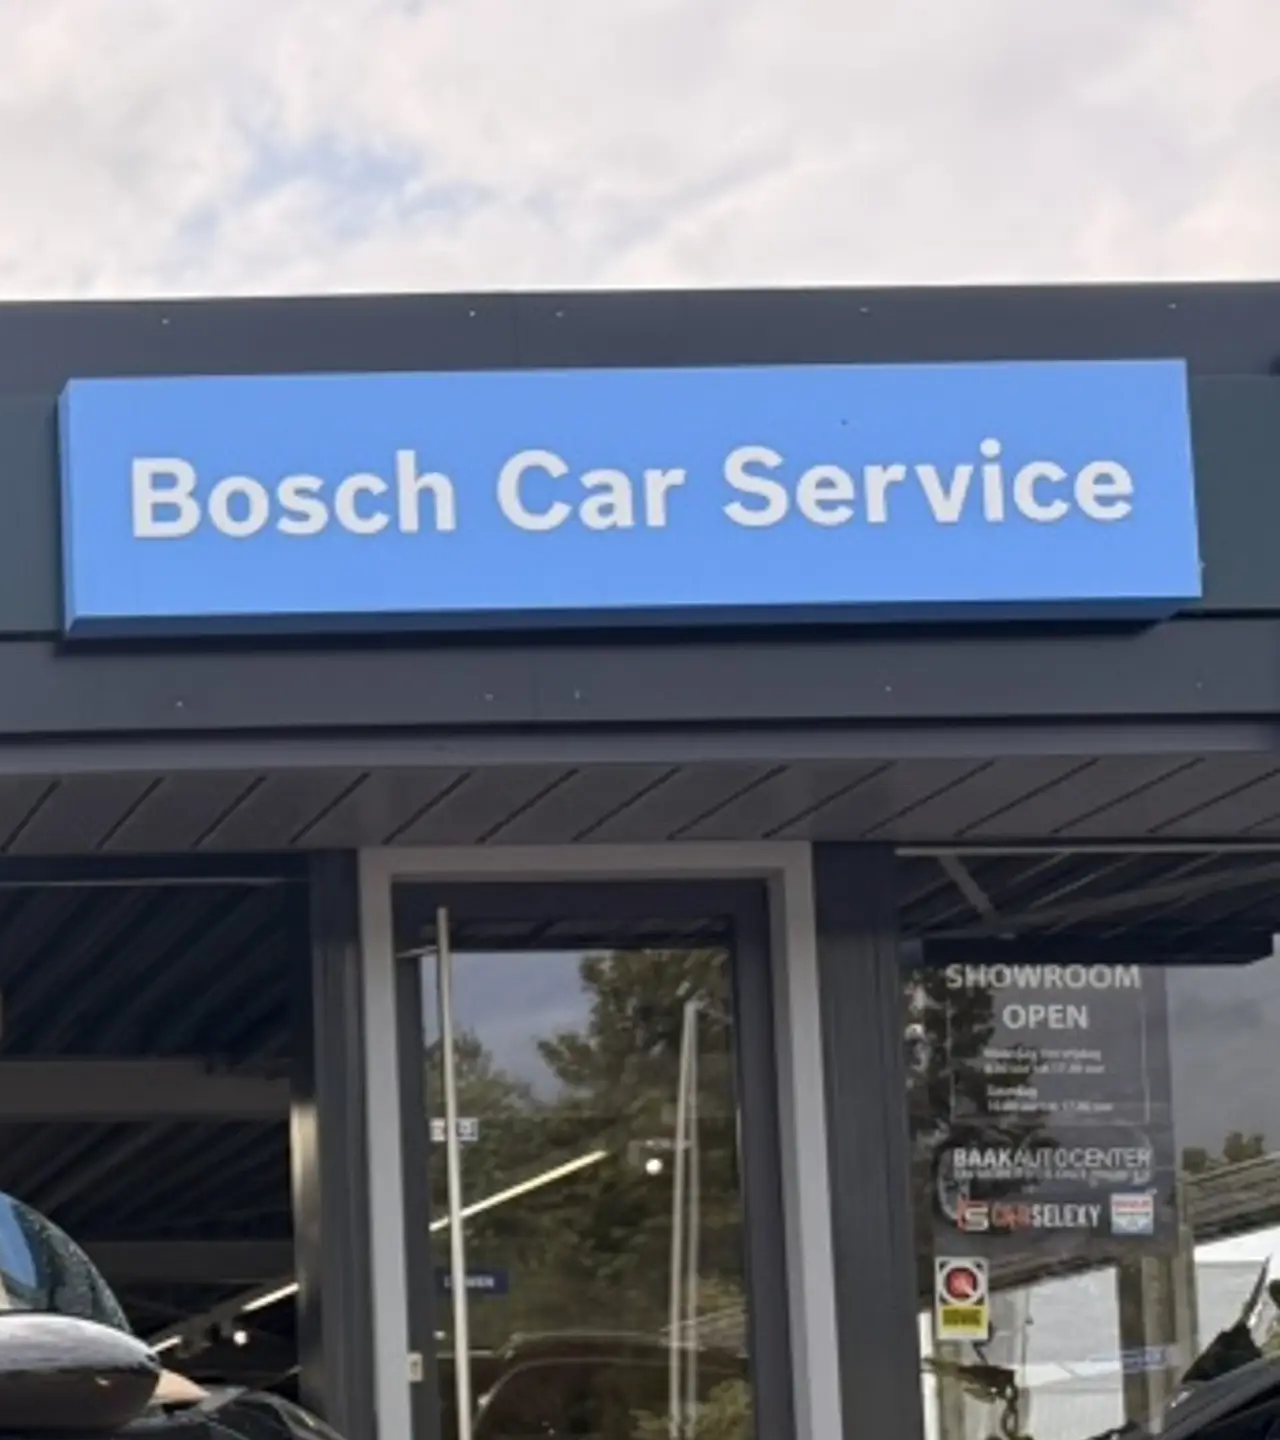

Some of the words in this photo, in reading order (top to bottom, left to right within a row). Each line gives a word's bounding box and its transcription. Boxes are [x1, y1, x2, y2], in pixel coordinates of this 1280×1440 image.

[130, 449, 456, 538] Bosch
[496, 449, 686, 531] Car
[723, 438, 1134, 526] Service
[945, 963, 1140, 989] SHOWROOM
[1002, 1003, 1089, 1030] OPEN
